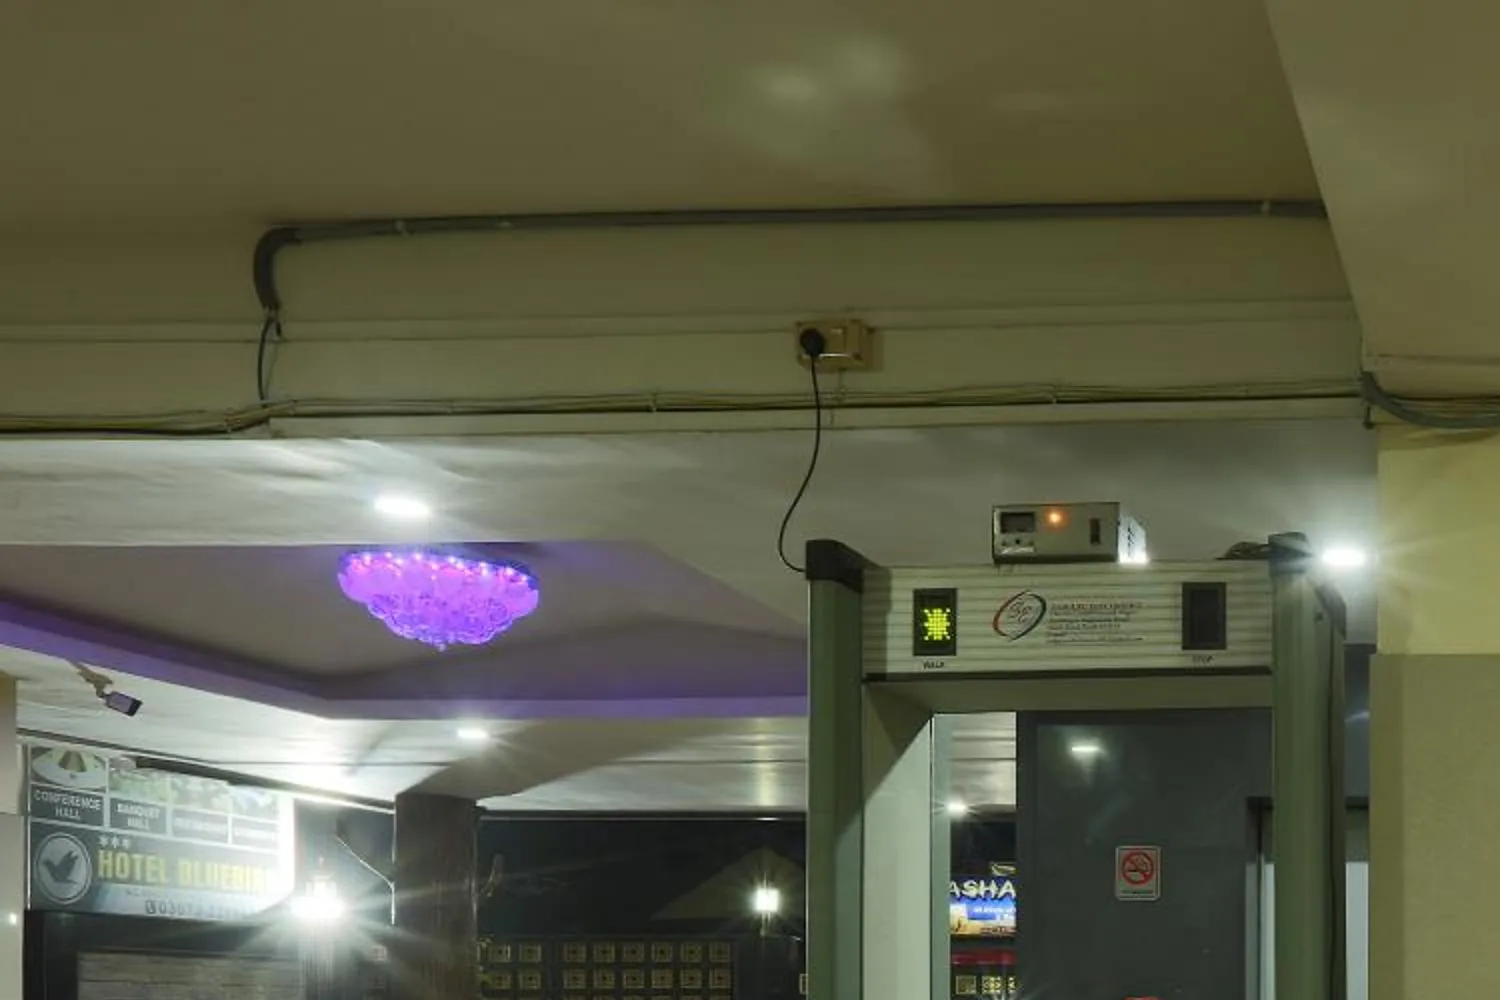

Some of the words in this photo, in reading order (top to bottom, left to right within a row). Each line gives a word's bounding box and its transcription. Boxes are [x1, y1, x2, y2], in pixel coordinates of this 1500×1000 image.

[33, 789, 102, 811] CONFERENCE
[55, 806, 82, 821] HALL
[117, 803, 161, 819] BANQUET
[98, 850, 170, 885] HOTEL
